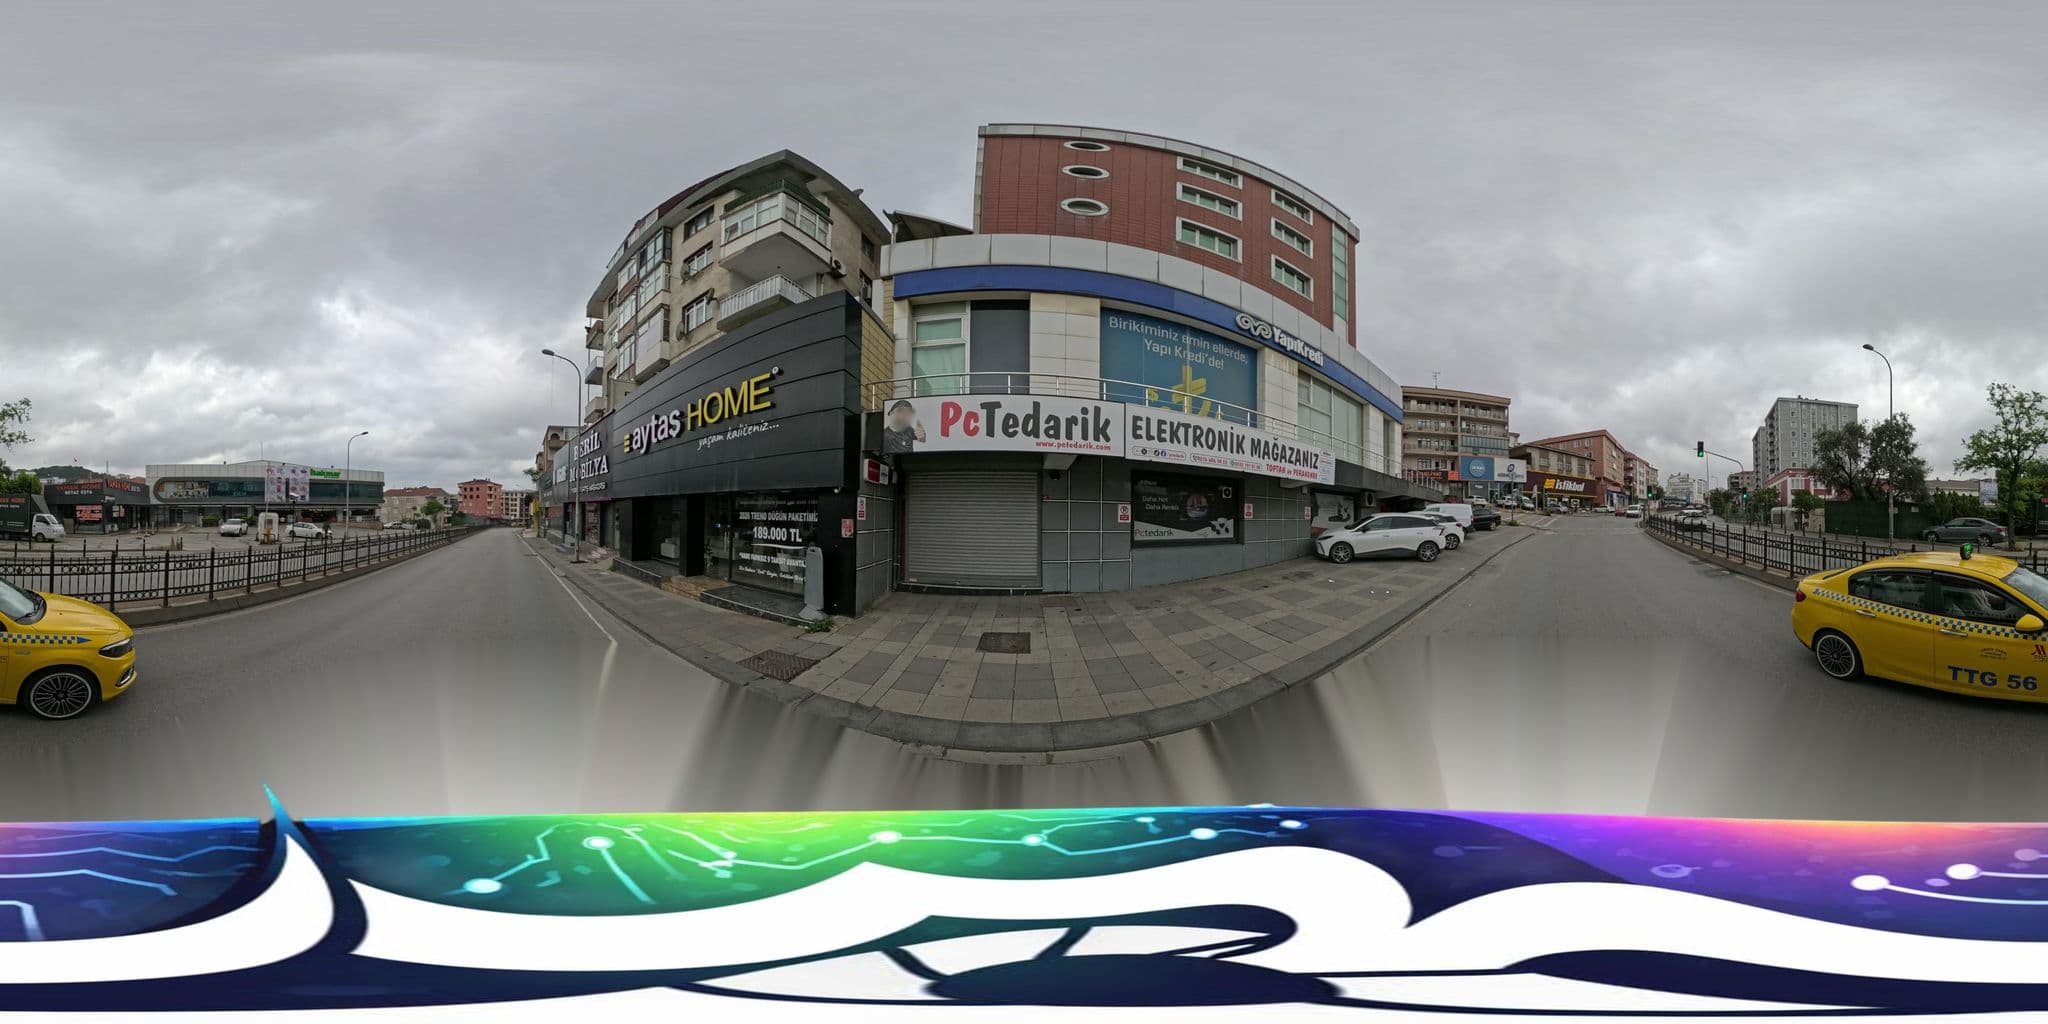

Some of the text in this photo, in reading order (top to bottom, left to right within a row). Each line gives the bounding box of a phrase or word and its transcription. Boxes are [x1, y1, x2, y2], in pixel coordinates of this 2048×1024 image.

[1109, 316, 1248, 365] Birikiminiz emin ellerde,
[1143, 338, 1224, 370] Yapı Kredi'de!
[1272, 326, 1324, 367] YapıKredi
[632, 372, 771, 454] aytaş HOME
[940, 400, 1112, 443] PcTedarik
[574, 430, 601, 460] BERİL
[697, 434, 724, 450] yaşam
[1035, 441, 1111, 451] www.pctedarik.com
[1132, 415, 1245, 455] ELEKTRONİK
[1250, 437, 1319, 469] MAĞAZANIZ
[1266, 463, 1286, 474] TOPTAN
[753, 526, 802, 542] 189.000 TL
[1948, 665, 2038, 691] TTG 56
